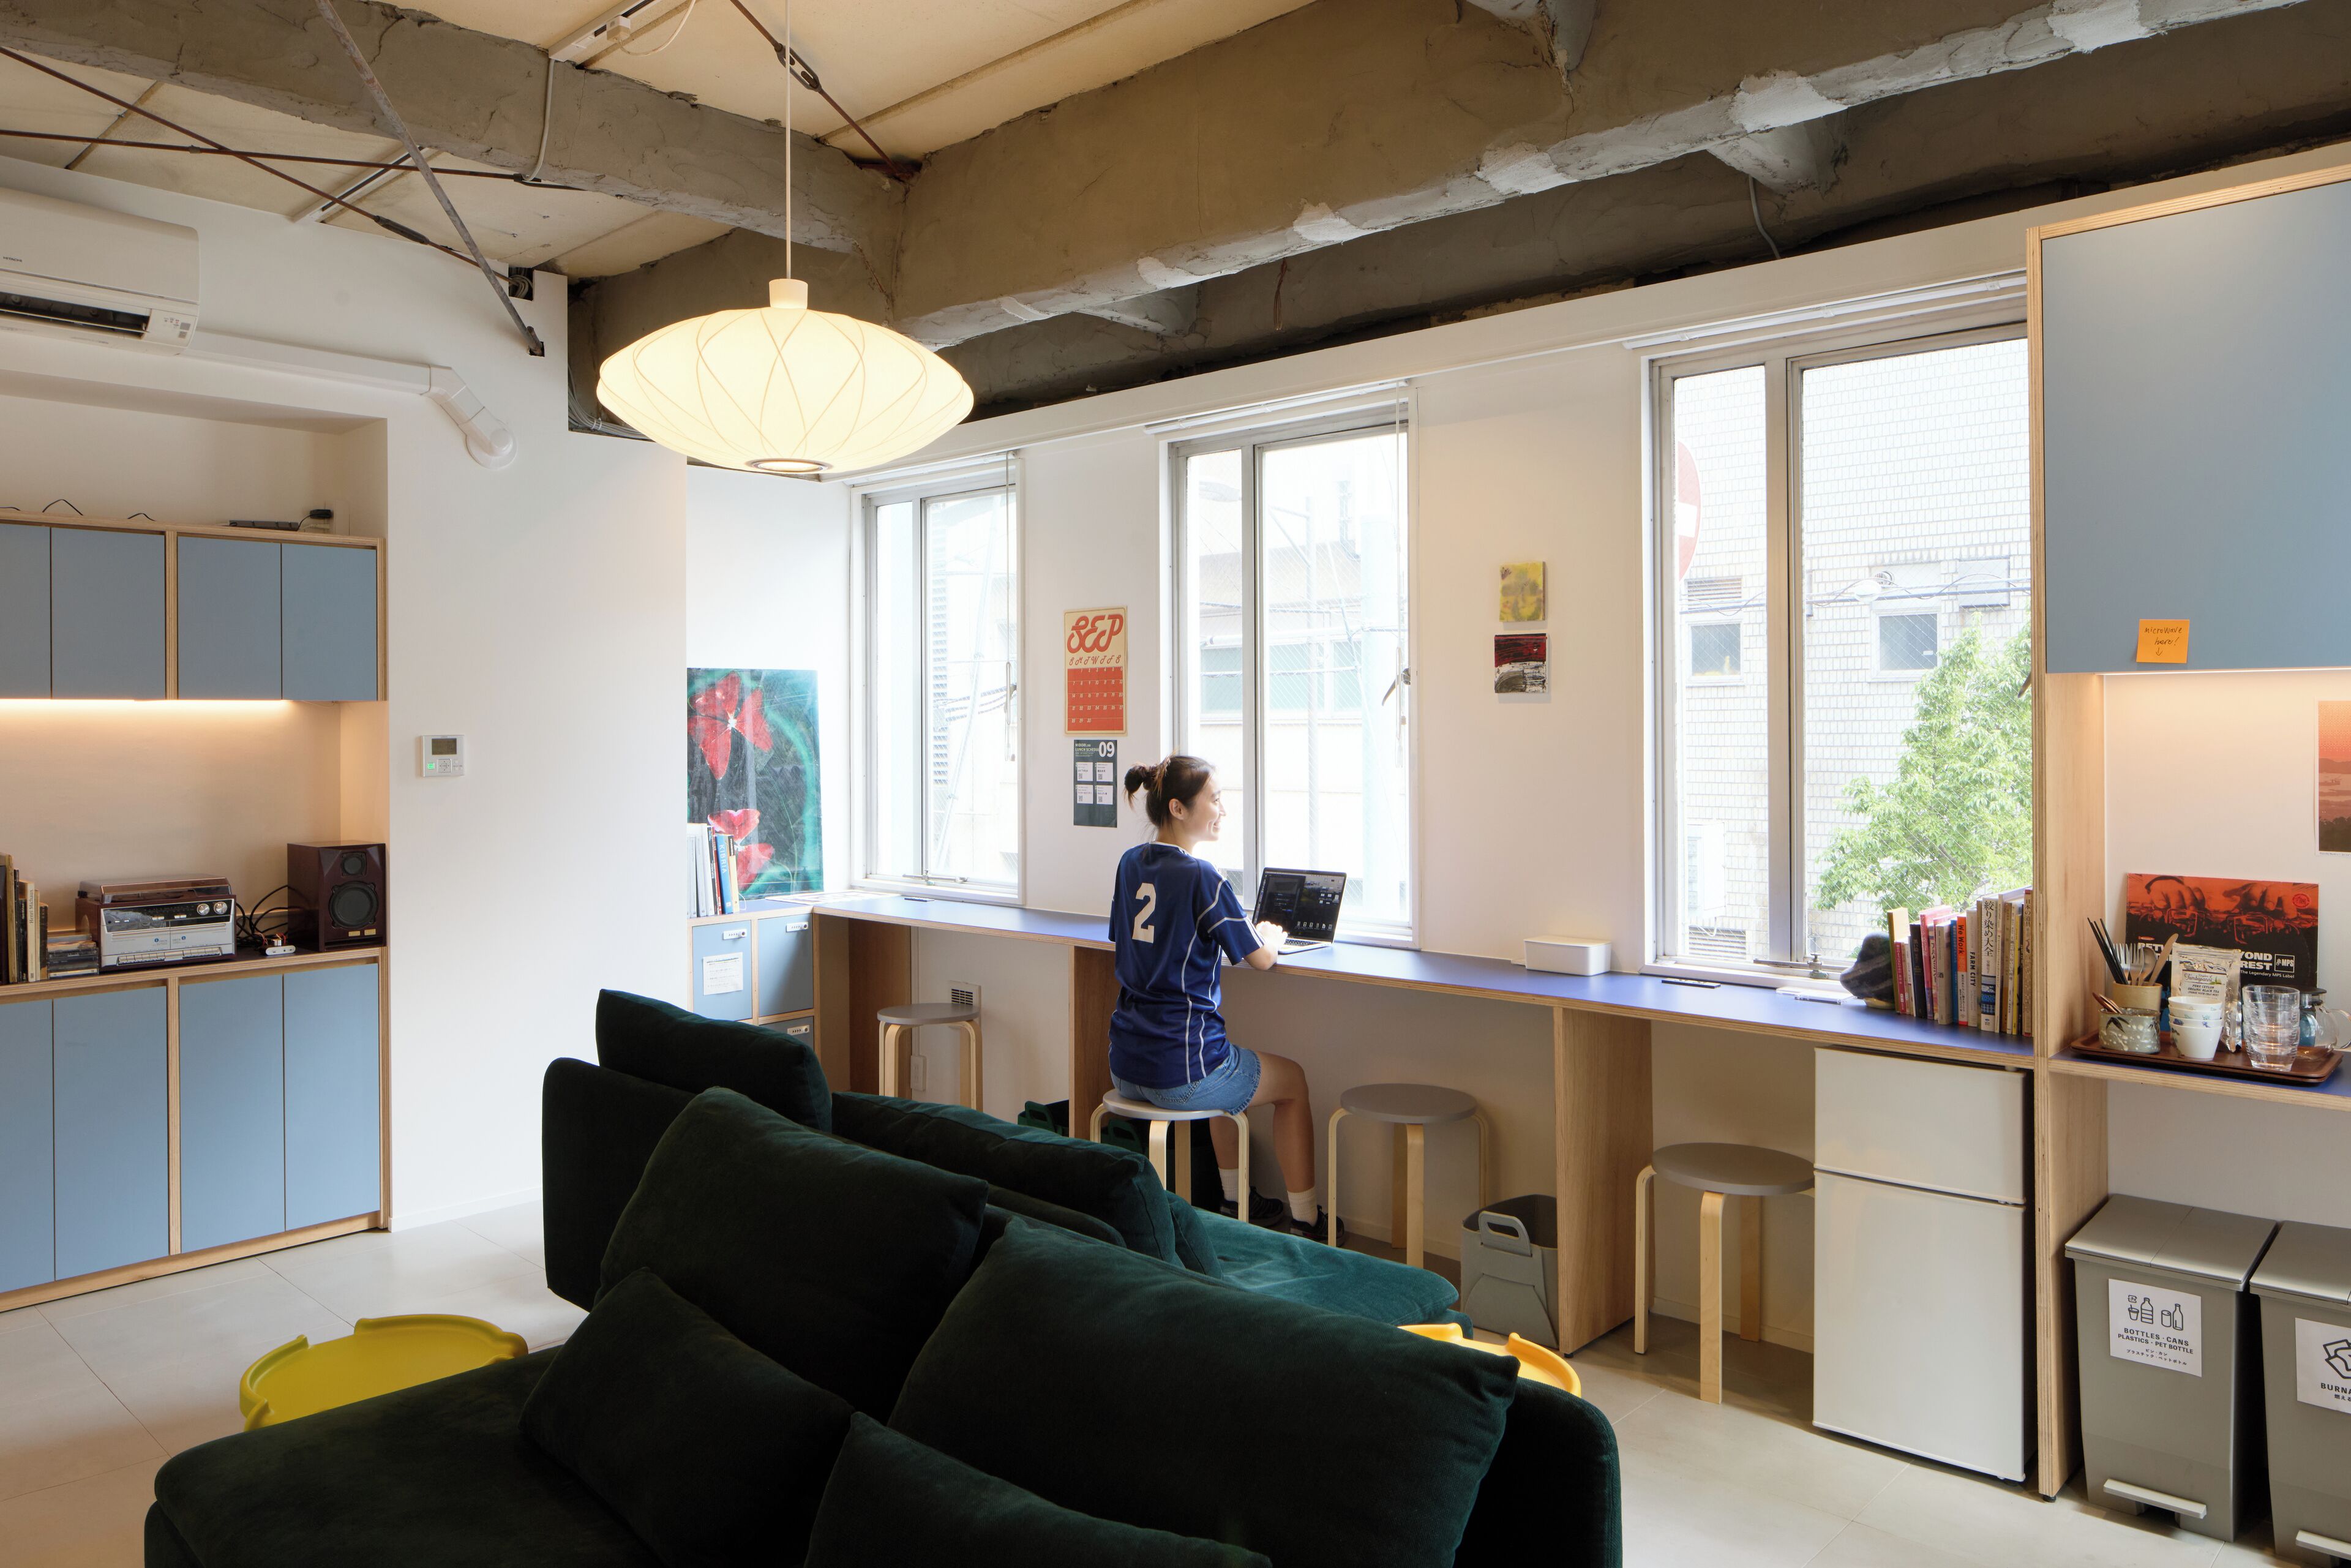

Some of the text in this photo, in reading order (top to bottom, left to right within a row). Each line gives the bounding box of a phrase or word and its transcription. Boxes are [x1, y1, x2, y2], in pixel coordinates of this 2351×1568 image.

[1067, 613, 1124, 654] SEP
[1091, 656, 1100, 665] W
[1099, 741, 1114, 757] 09
[719, 844, 727, 874] KIBRIA
[1132, 882, 1157, 943] 2
[1958, 925, 1964, 935] We
[1984, 901, 1994, 957] 絞り染め大全
[2240, 951, 2273, 961] YOND
[2281, 959, 2293, 967] MPS
[2240, 960, 2273, 970] REST
[2118, 1334, 2149, 1345] PLASTICS
[2169, 1344, 2194, 1354] BOTTLE
[2124, 1327, 2189, 1346] BOTTLES CANS
